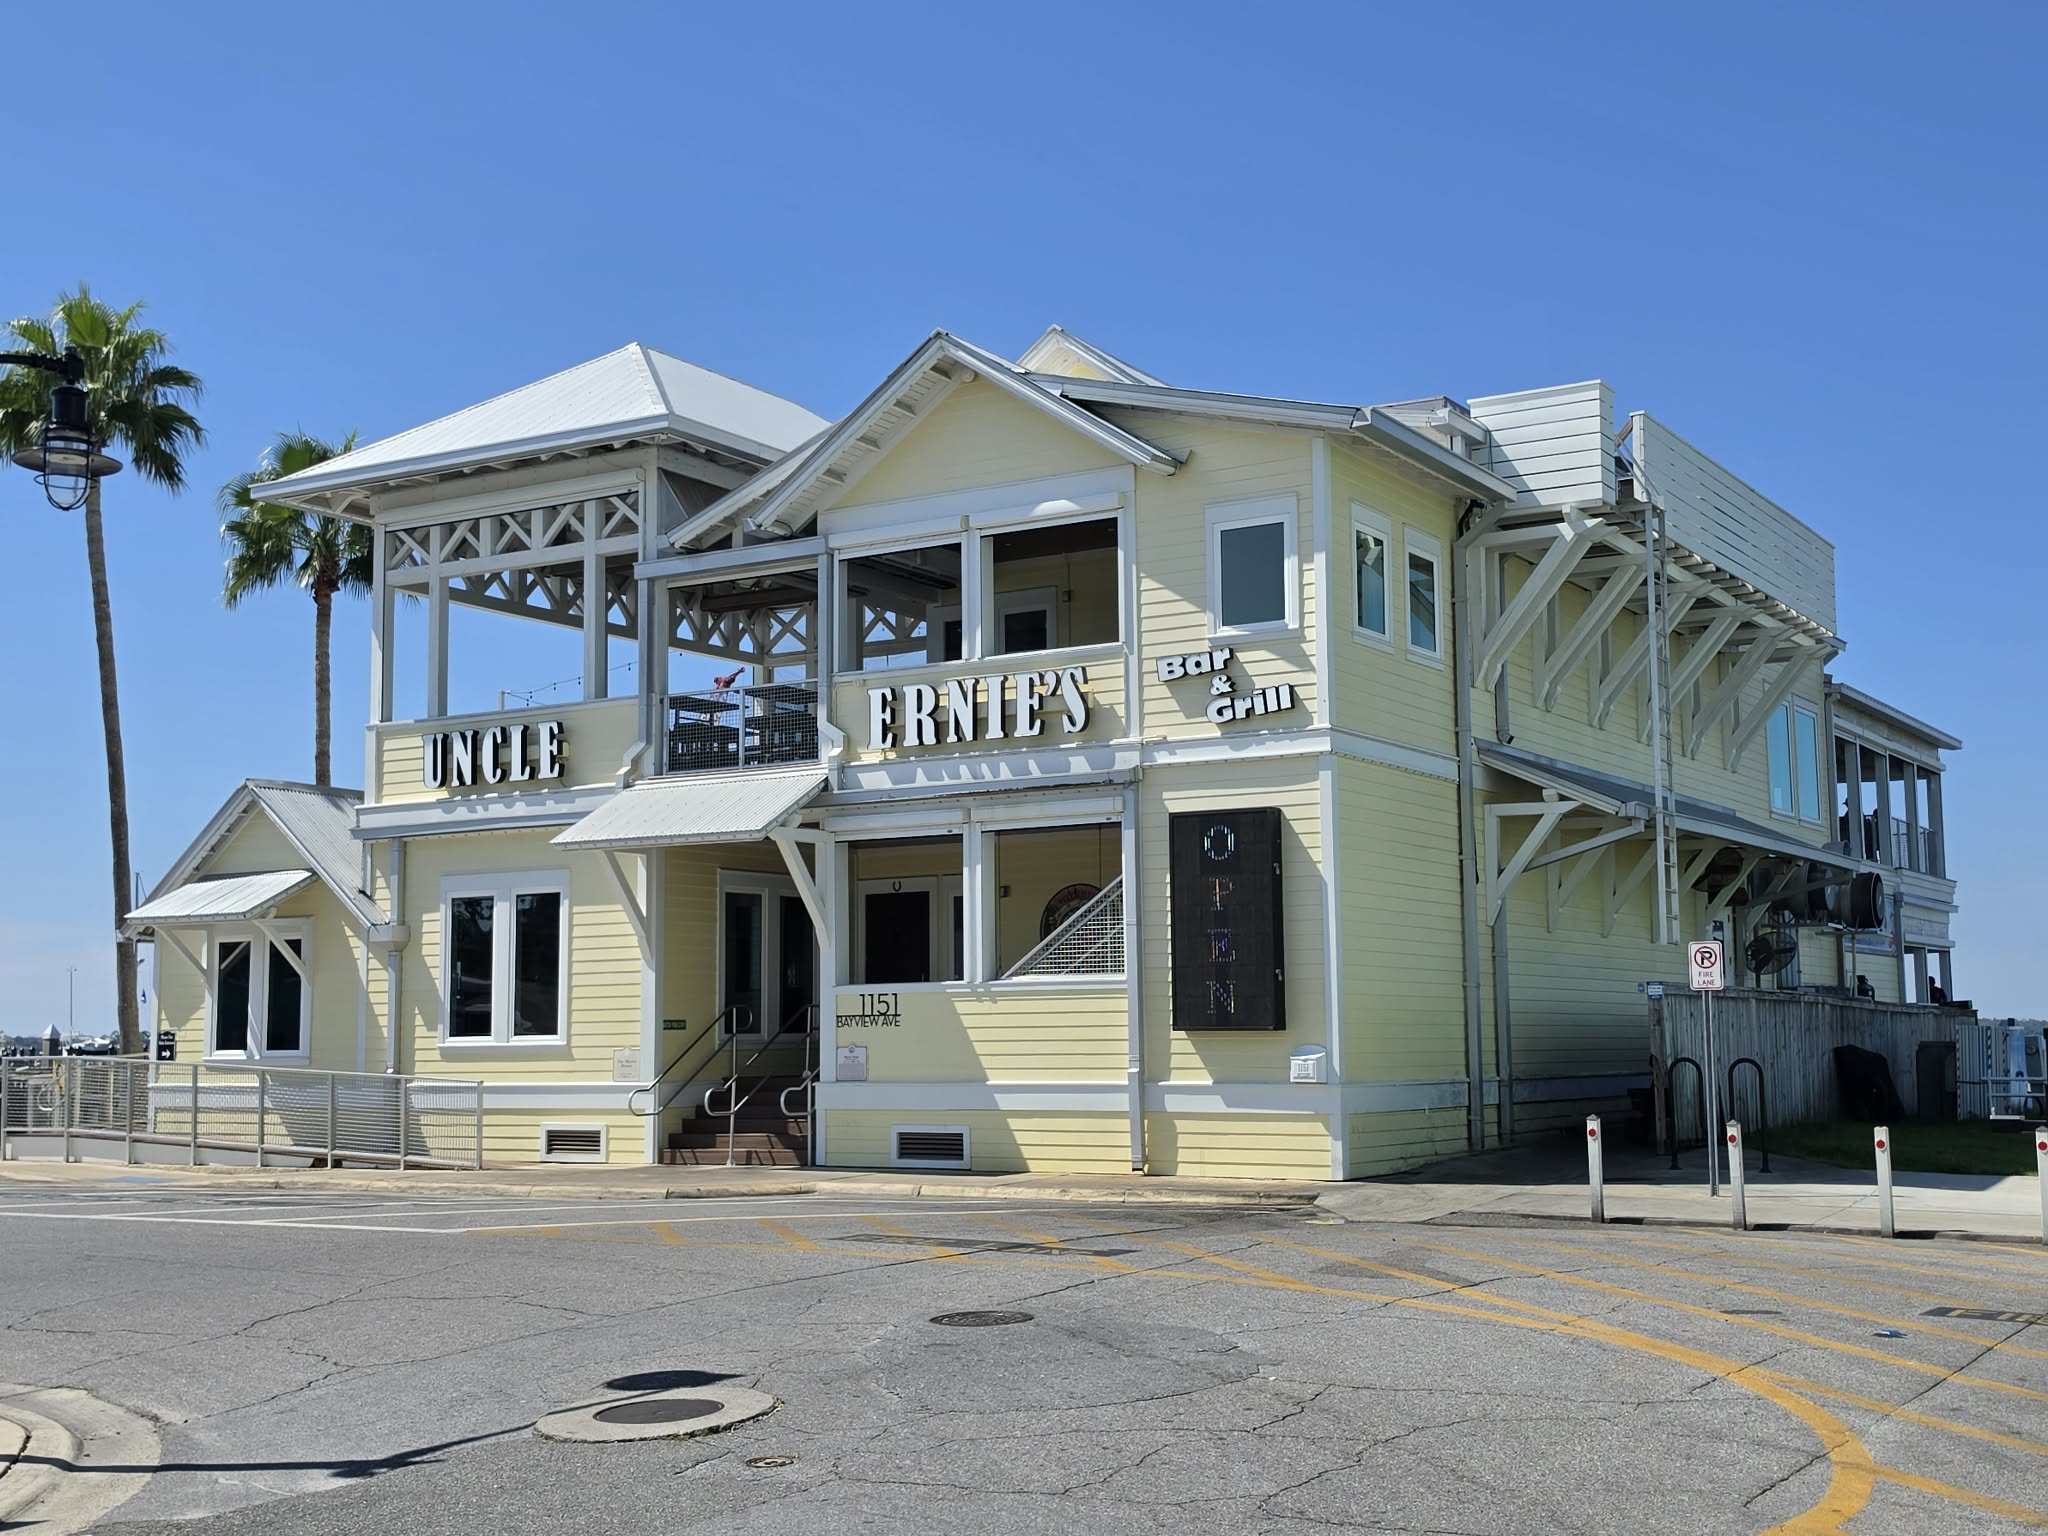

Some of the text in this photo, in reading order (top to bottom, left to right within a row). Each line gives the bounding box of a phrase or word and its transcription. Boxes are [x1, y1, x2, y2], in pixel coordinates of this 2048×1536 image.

[1157, 647, 1233, 682] Bar
[1206, 683, 1305, 723] Grill
[1209, 674, 1235, 696] &
[867, 666, 1088, 750] ERNIE'S
[422, 720, 565, 789] UNCLE
[1204, 824, 1236, 1013] OPEN
[836, 1015, 902, 1028] BAYVIEW AVE
[858, 993, 898, 1016] 1151
